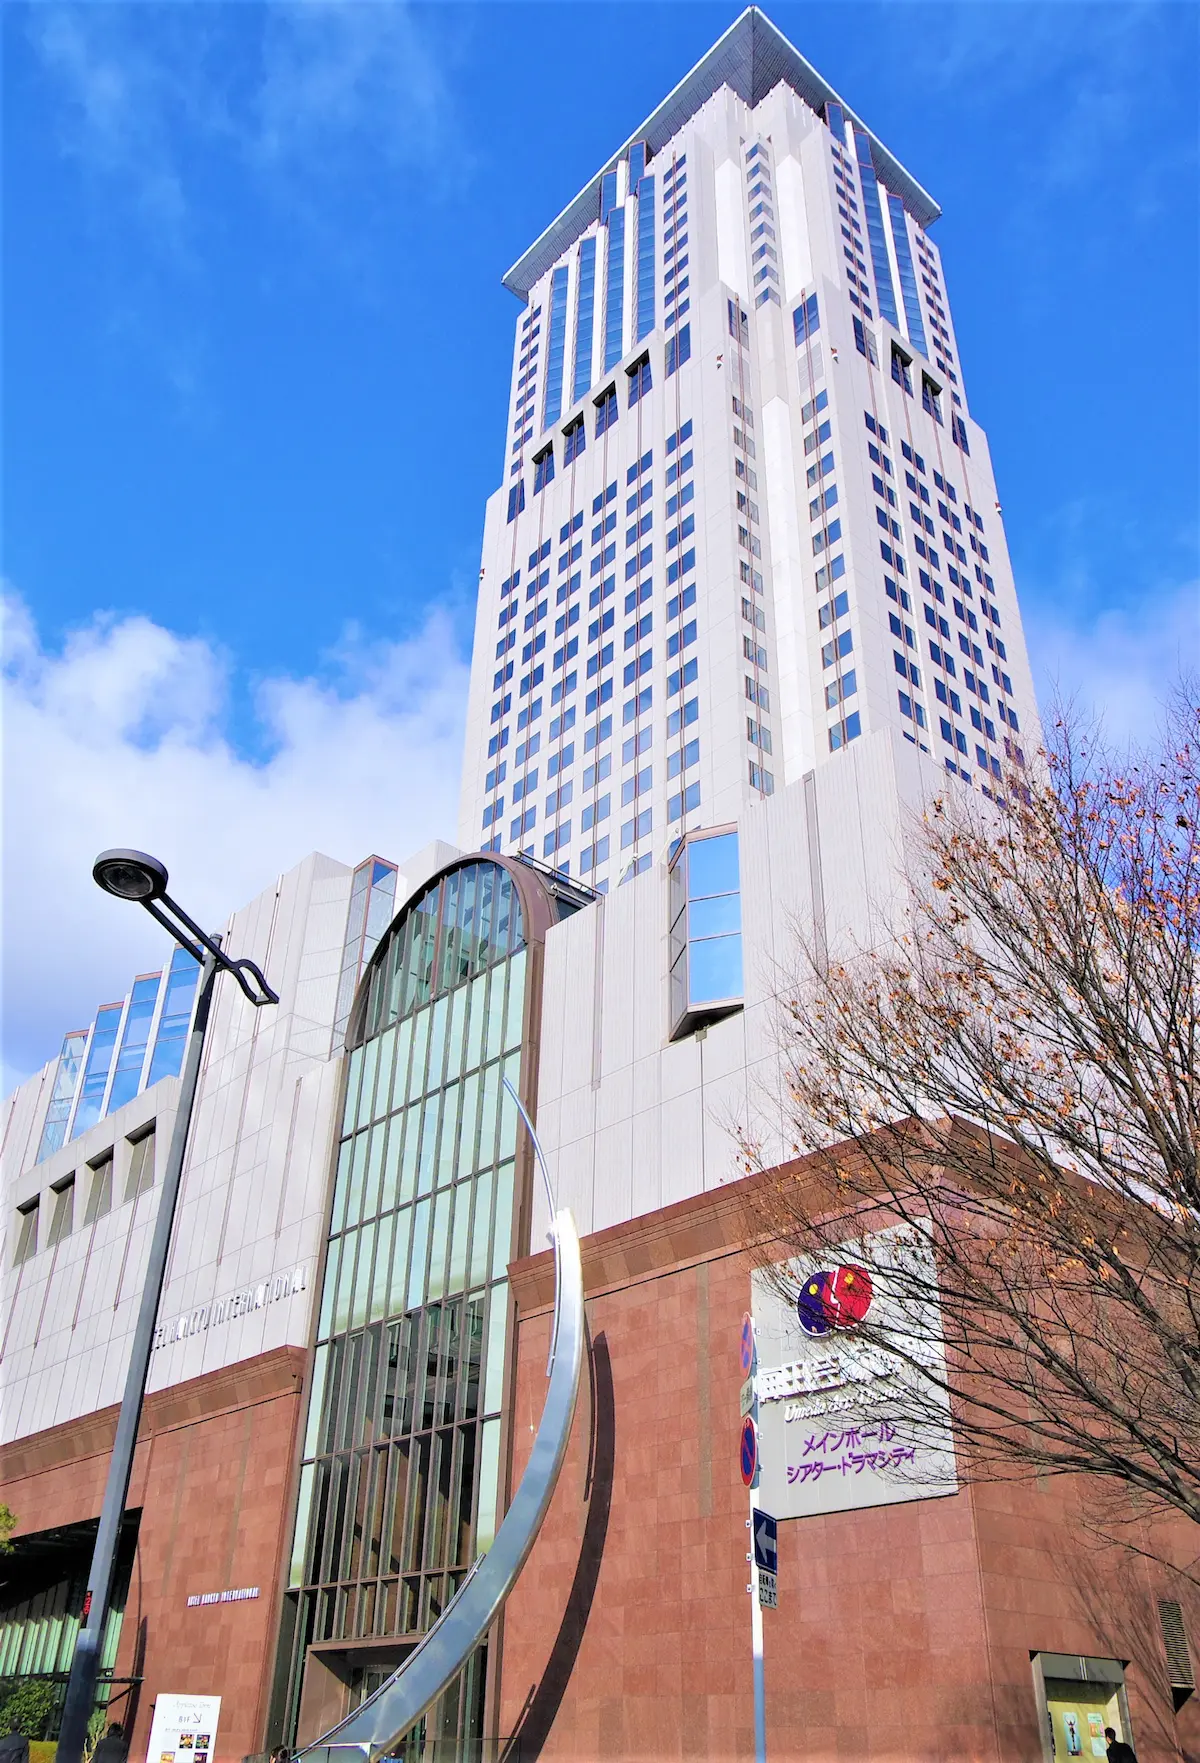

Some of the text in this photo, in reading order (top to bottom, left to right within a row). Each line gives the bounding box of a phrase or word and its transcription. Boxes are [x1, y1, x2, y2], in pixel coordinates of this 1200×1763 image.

[169, 1306, 210, 1344] HANKYU
[212, 1265, 308, 1327] INTERNATIONAL
[784, 1399, 826, 1423] Umeda
[802, 1420, 896, 1457] メインホール
